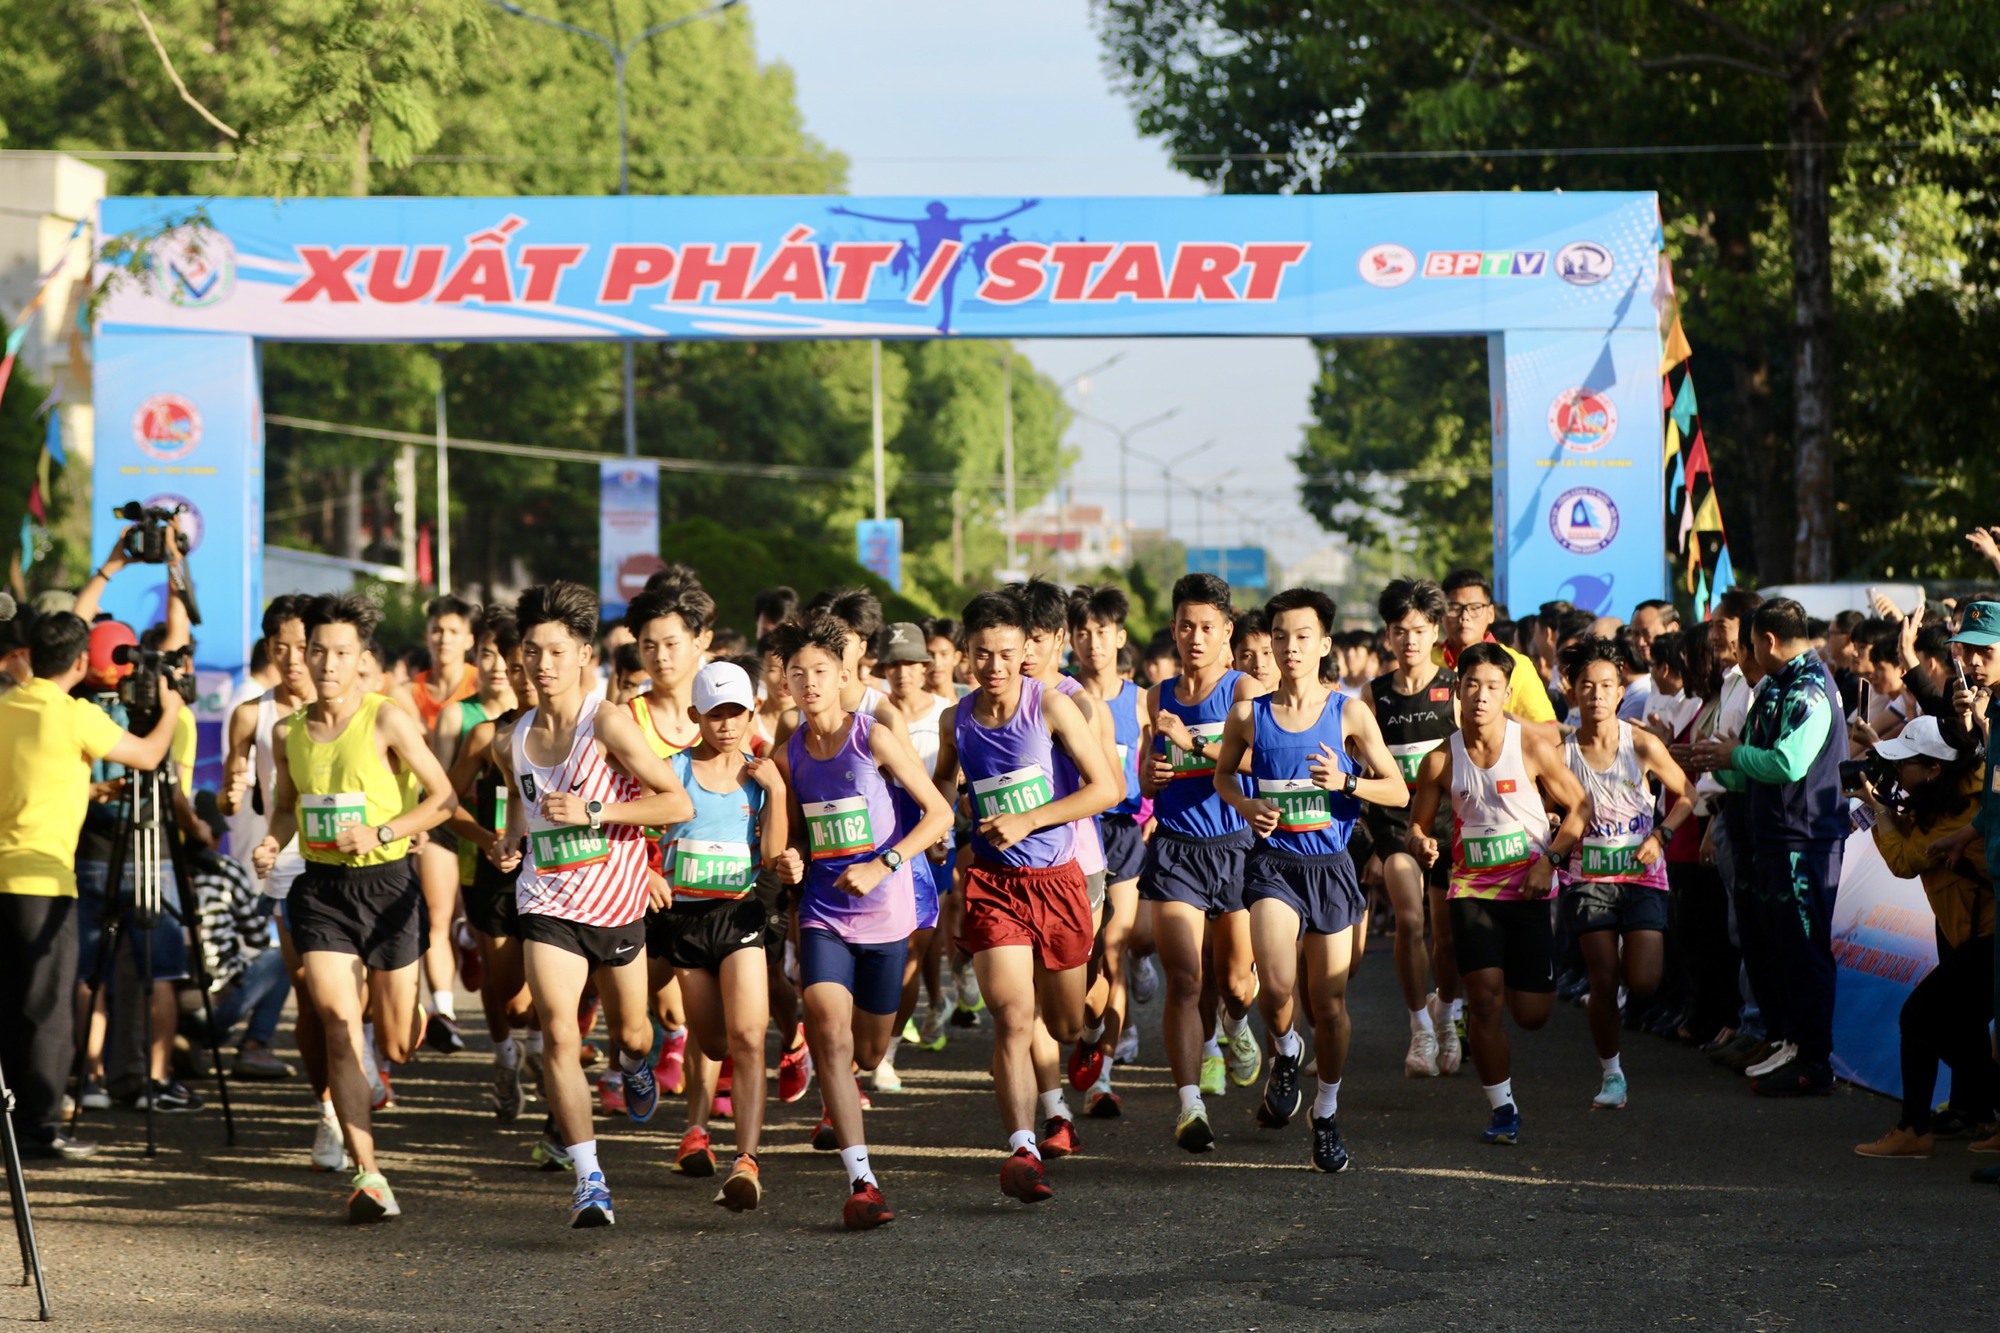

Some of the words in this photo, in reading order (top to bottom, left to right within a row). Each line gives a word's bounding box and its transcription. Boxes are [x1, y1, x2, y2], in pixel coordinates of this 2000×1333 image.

[280, 213, 589, 304] XUẤT
[597, 224, 901, 304] PHÁT
[907, 238, 963, 305] /
[976, 241, 1312, 304] START
[1424, 252, 1544, 277] BPTV
[1387, 711, 1439, 726] ANTA
[983, 782, 1045, 816] M-1161
[537, 828, 602, 862] M-1148
[811, 815, 873, 847] M-1162
[1468, 836, 1524, 863] M-1145
[681, 857, 747, 887] M-1125
